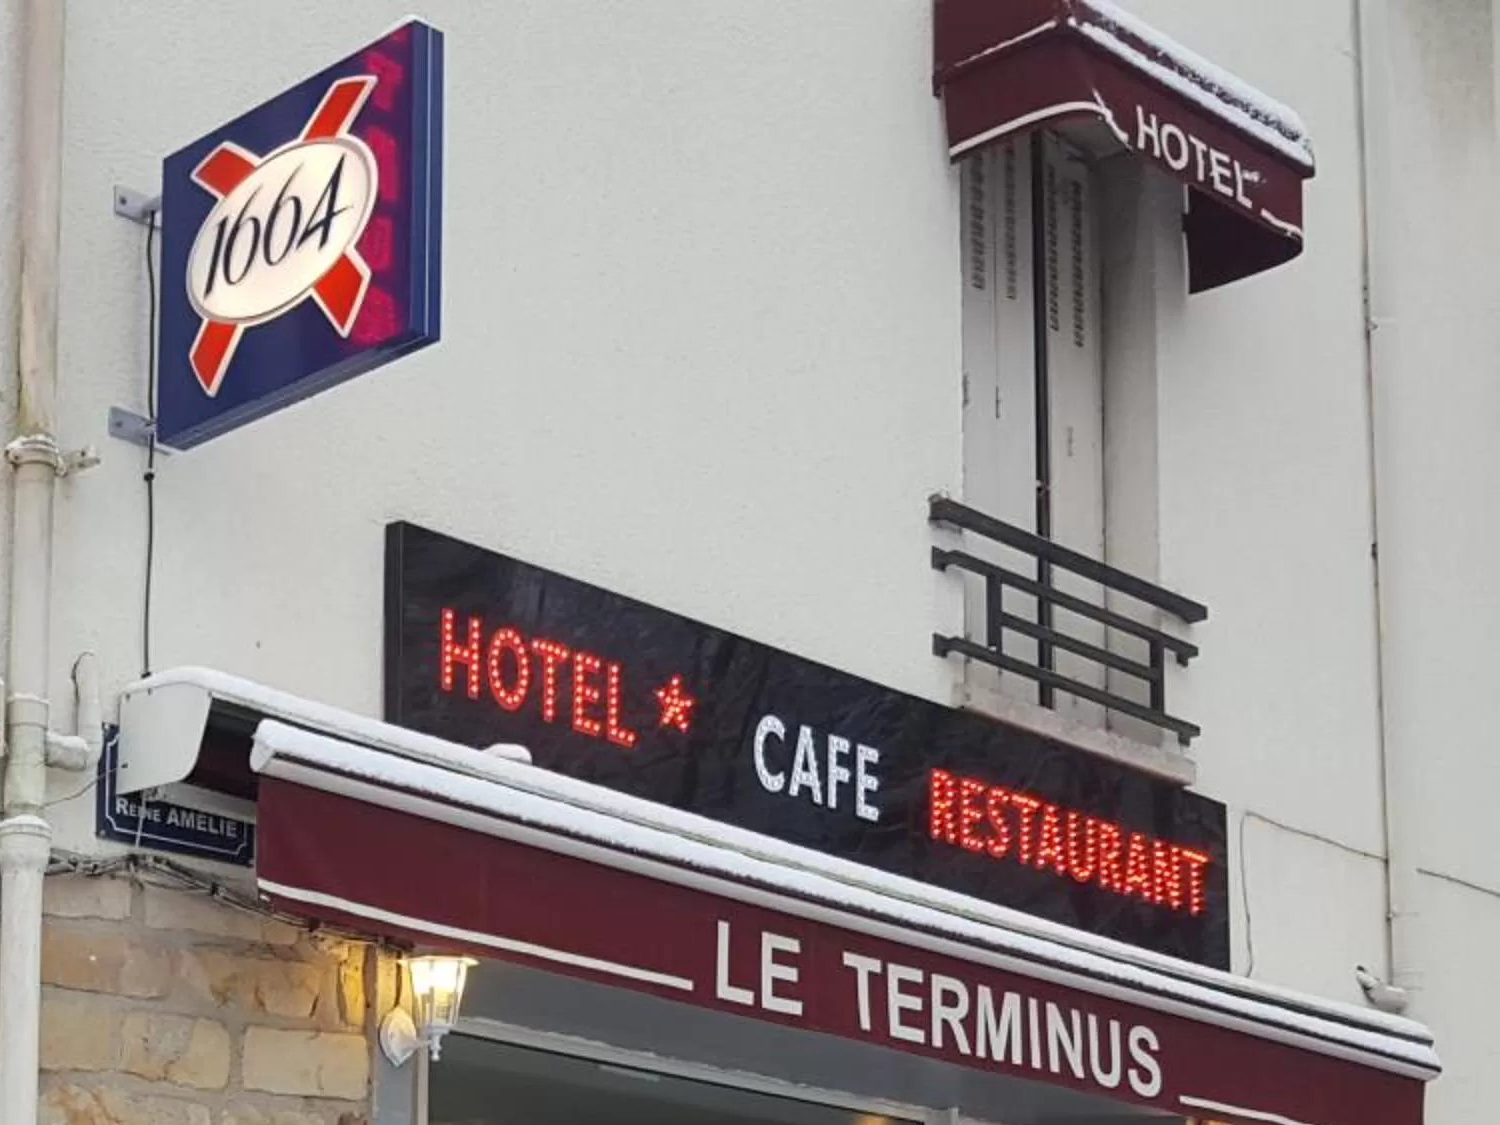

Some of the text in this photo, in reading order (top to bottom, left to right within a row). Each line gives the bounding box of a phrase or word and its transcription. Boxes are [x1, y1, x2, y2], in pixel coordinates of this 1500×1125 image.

[203, 152, 356, 301] 1664
[1134, 104, 1253, 209] HOTEL
[440, 607, 640, 749] HOTEL
[166, 807, 239, 838] AMELIE
[753, 714, 880, 822] CAFE
[930, 767, 1212, 915] RESTAURANT
[715, 920, 1165, 1098] LE TERMINUS
